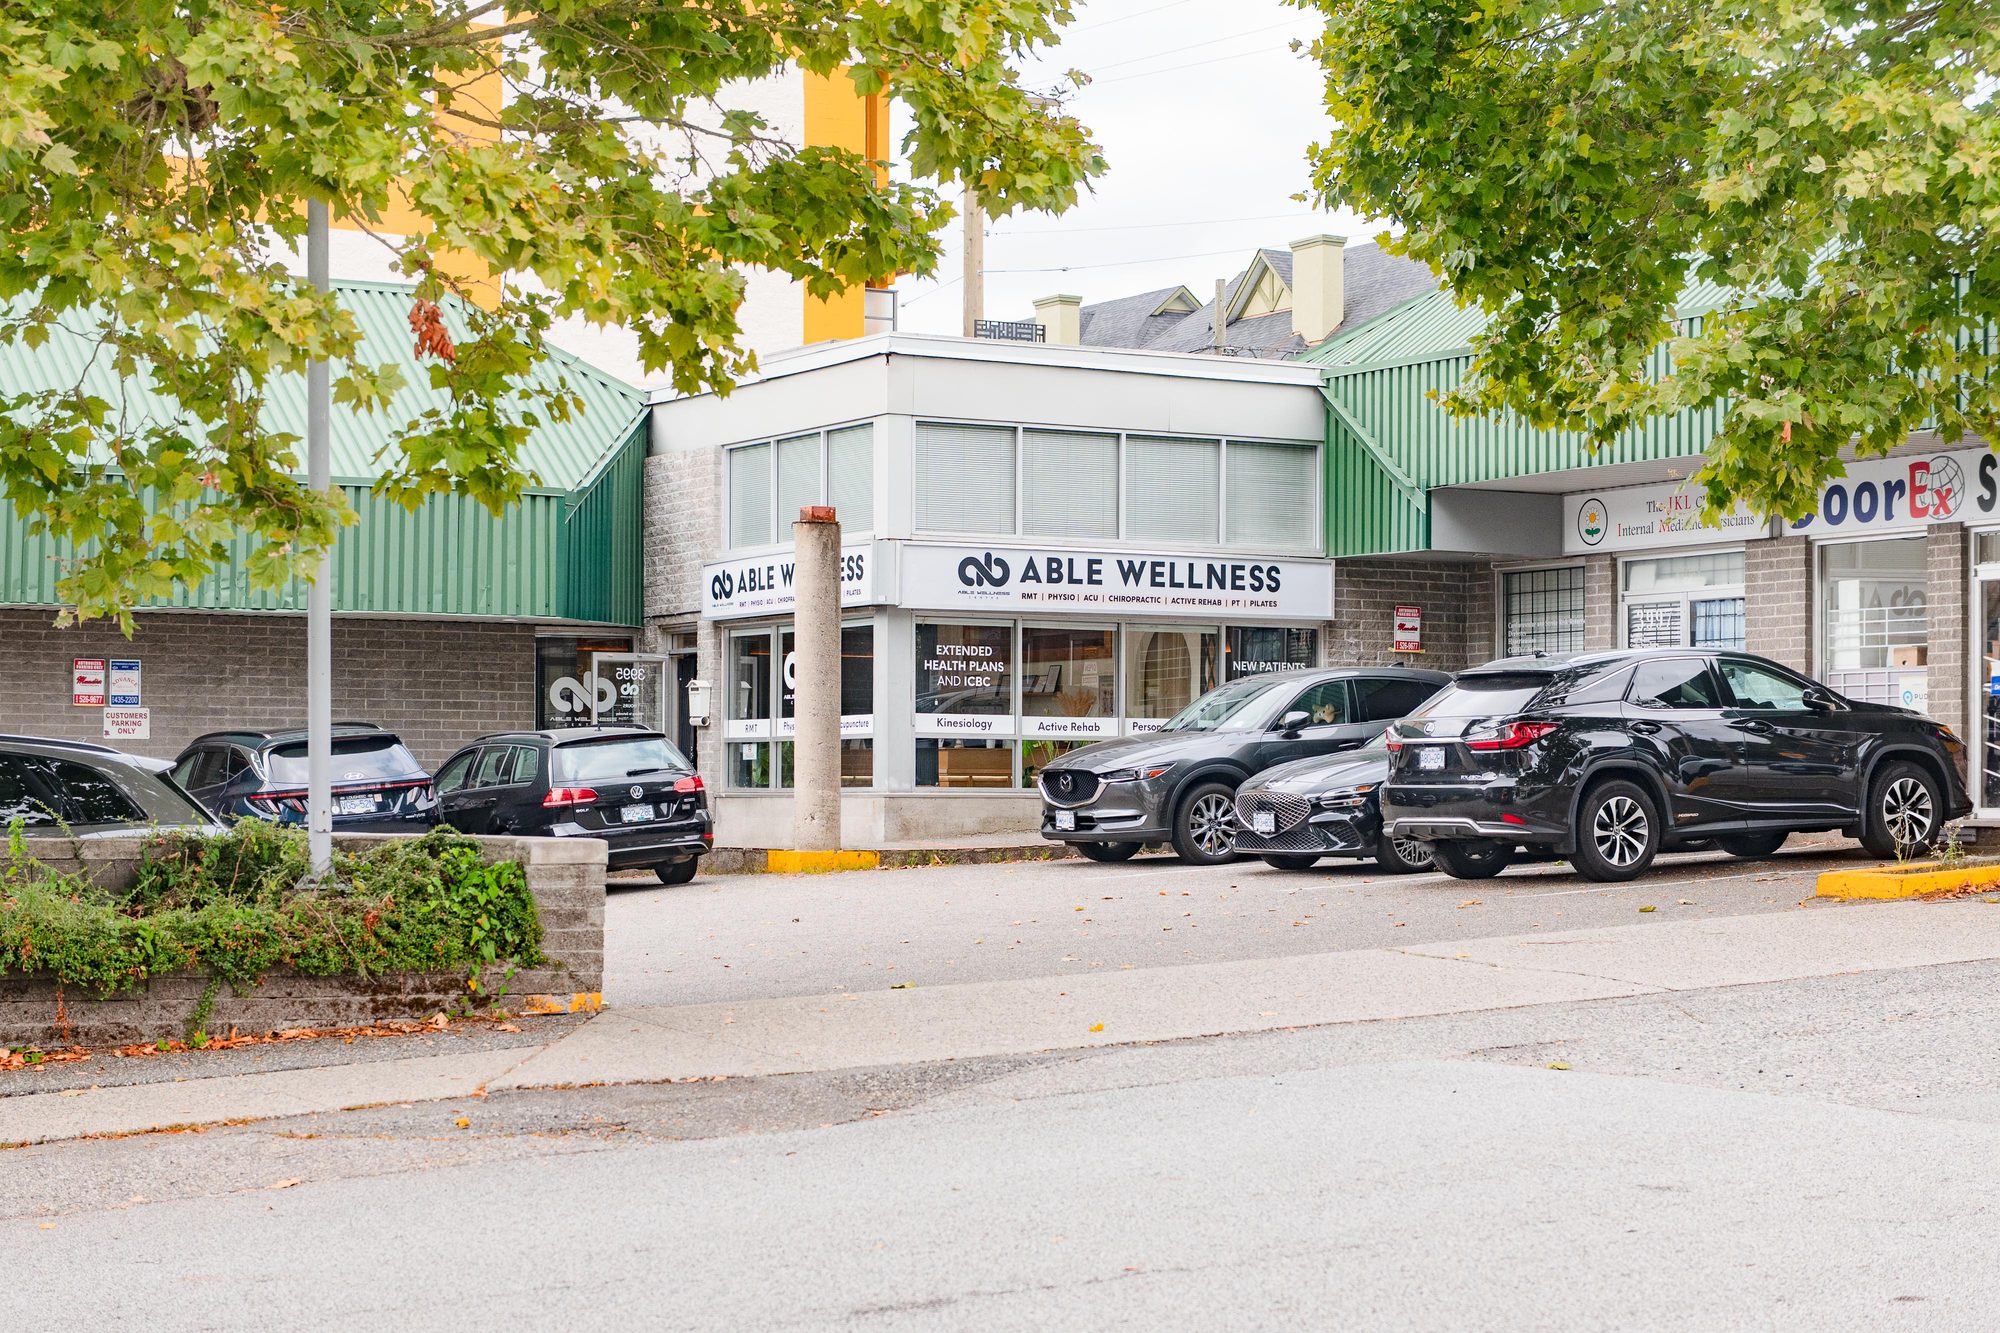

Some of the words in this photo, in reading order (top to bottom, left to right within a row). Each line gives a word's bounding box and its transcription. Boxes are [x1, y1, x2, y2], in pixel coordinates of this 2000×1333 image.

[1791, 461, 1953, 529] oorEx
[1618, 521, 1654, 537] Internal
[737, 565, 775, 593] ABLE
[1020, 556, 1103, 586] ABLE
[1116, 559, 1281, 593] WELLNESS
[1048, 593, 1075, 601] PHYSIO
[1083, 594, 1099, 602] ACU
[1109, 595, 1161, 604] CHIROPRACTIC
[1171, 597, 1196, 605] ACTIVE
[1250, 600, 1278, 608] PILATES
[936, 645, 993, 657] EXTENDED
[924, 660, 968, 671] HEALTH
[969, 661, 1004, 672] PLANS
[1232, 661, 1258, 671] NEW
[112, 676, 138, 687] ADVANCE
[937, 675, 961, 687] AND
[964, 676, 991, 687] ICBC
[79, 695, 103, 704] 526-9677
[114, 696, 138, 704] 435-2200
[745, 724, 758, 733] RMT
[784, 721, 794, 734] Phys
[840, 720, 869, 730] cupuncture
[936, 718, 992, 731] Kinesiology
[1037, 722, 1068, 732] Active
[1070, 722, 1100, 732] Rehab
[1132, 722, 1162, 731] Person
